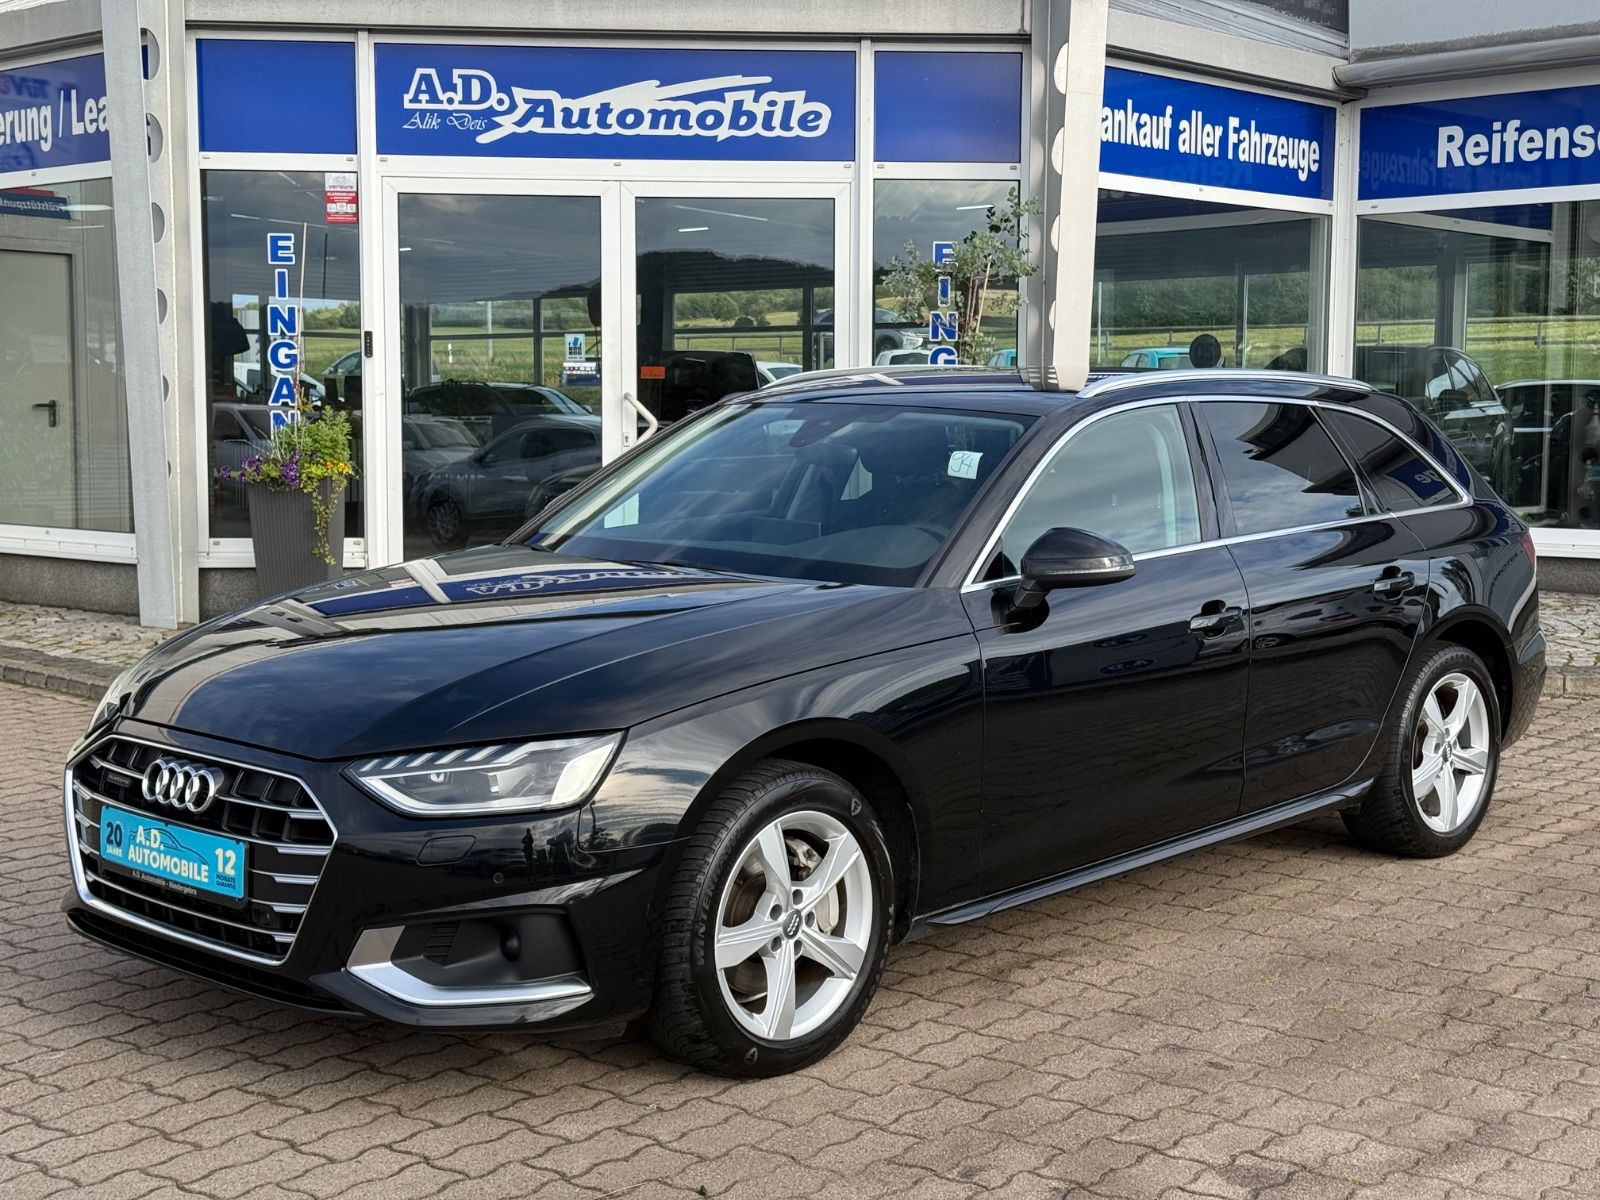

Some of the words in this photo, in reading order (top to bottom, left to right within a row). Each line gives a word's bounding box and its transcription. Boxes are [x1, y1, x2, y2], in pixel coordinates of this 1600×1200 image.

[402, 67, 510, 112] A.D.
[508, 86, 832, 142] Automobile
[402, 111, 441, 130] Alik
[447, 112, 488, 131] Deis
[1101, 98, 1173, 150] ankauf
[1178, 109, 1223, 158] aller
[1228, 116, 1319, 182] Fahrzeuge
[1437, 119, 1600, 168] Reifens
[106, 821, 122, 847] 20
[136, 825, 165, 851] A.D.
[128, 845, 208, 882] AUTOMOBILE
[215, 848, 236, 876] 12
